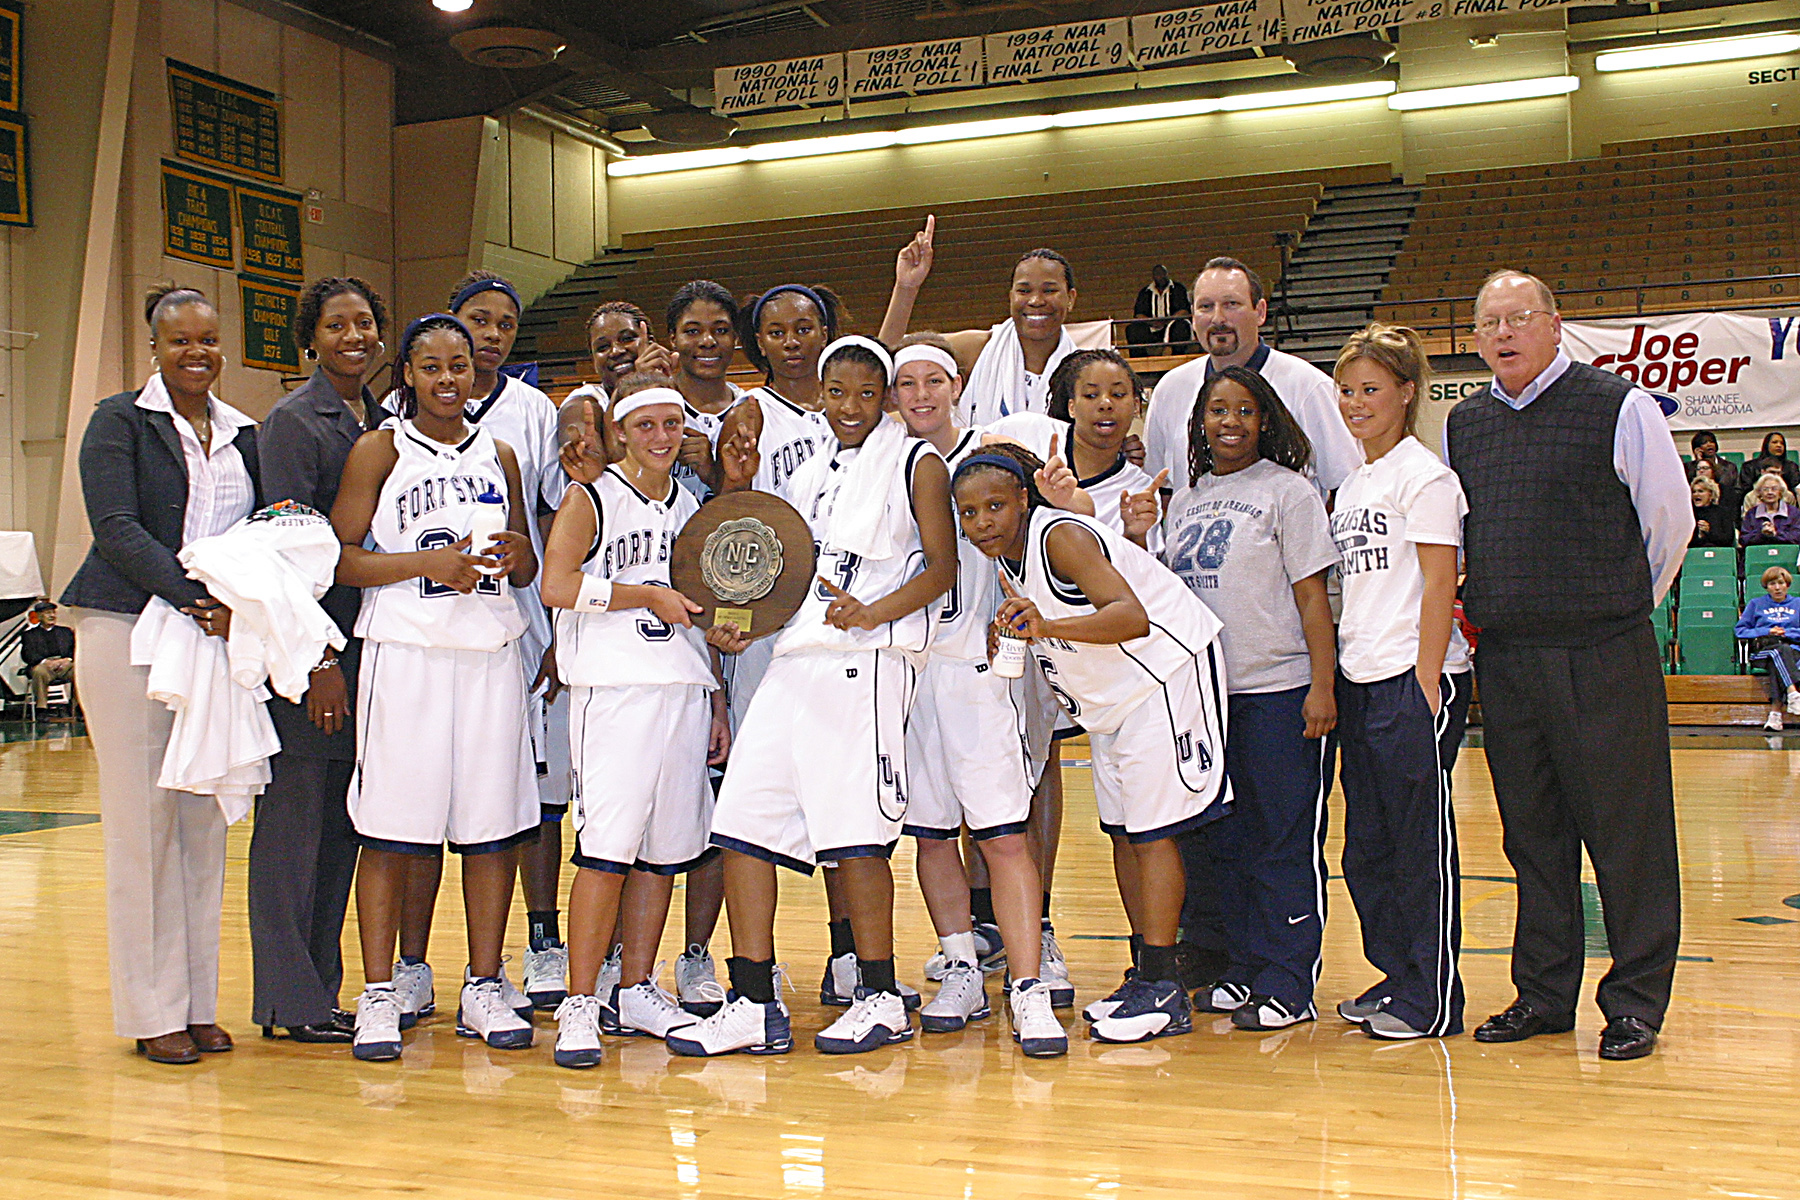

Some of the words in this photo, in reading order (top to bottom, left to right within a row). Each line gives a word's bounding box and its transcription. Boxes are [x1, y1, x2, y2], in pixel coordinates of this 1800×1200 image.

[1154, 8, 1203, 29] 1995
[1215, 0, 1256, 18] NAIA
[1454, 0, 1508, 15] FINAL
[1007, 29, 1053, 47] 1994
[1065, 23, 1105, 40] NAIA
[1162, 15, 1251, 42] NATIONAL
[1293, 20, 1344, 41] FINAL
[1354, 9, 1404, 30] POLL
[868, 47, 912, 64] 1993
[922, 42, 961, 57] NAIA
[1013, 38, 1100, 61] NATIONAL
[1137, 41, 1190, 61] FINAL
[1201, 31, 1252, 51] POLL
[734, 64, 776, 81] 1990
[786, 58, 823, 74] NAIA
[869, 55, 960, 78] NATIONAL
[993, 61, 1043, 79] FINAL
[1052, 53, 1100, 71] POLL
[1748, 67, 1799, 85] SECT
[740, 72, 818, 94] NATIONAL
[854, 76, 903, 93] FINAL
[913, 70, 962, 86] POLL
[721, 92, 766, 109] FINAL
[775, 85, 818, 102] POLL
[1617, 324, 1699, 363] Joe
[1768, 316, 1800, 361] Y
[1685, 404, 1754, 417] OKLAHOMA
[770, 436, 816, 490] FORT
[396, 476, 449, 534] FORT
[1223, 500, 1262, 519] ARKANSAS
[603, 528, 655, 580] FORT
[1172, 518, 1236, 575] 28
[1176, 729, 1214, 773] UA
[879, 753, 908, 804] UA
